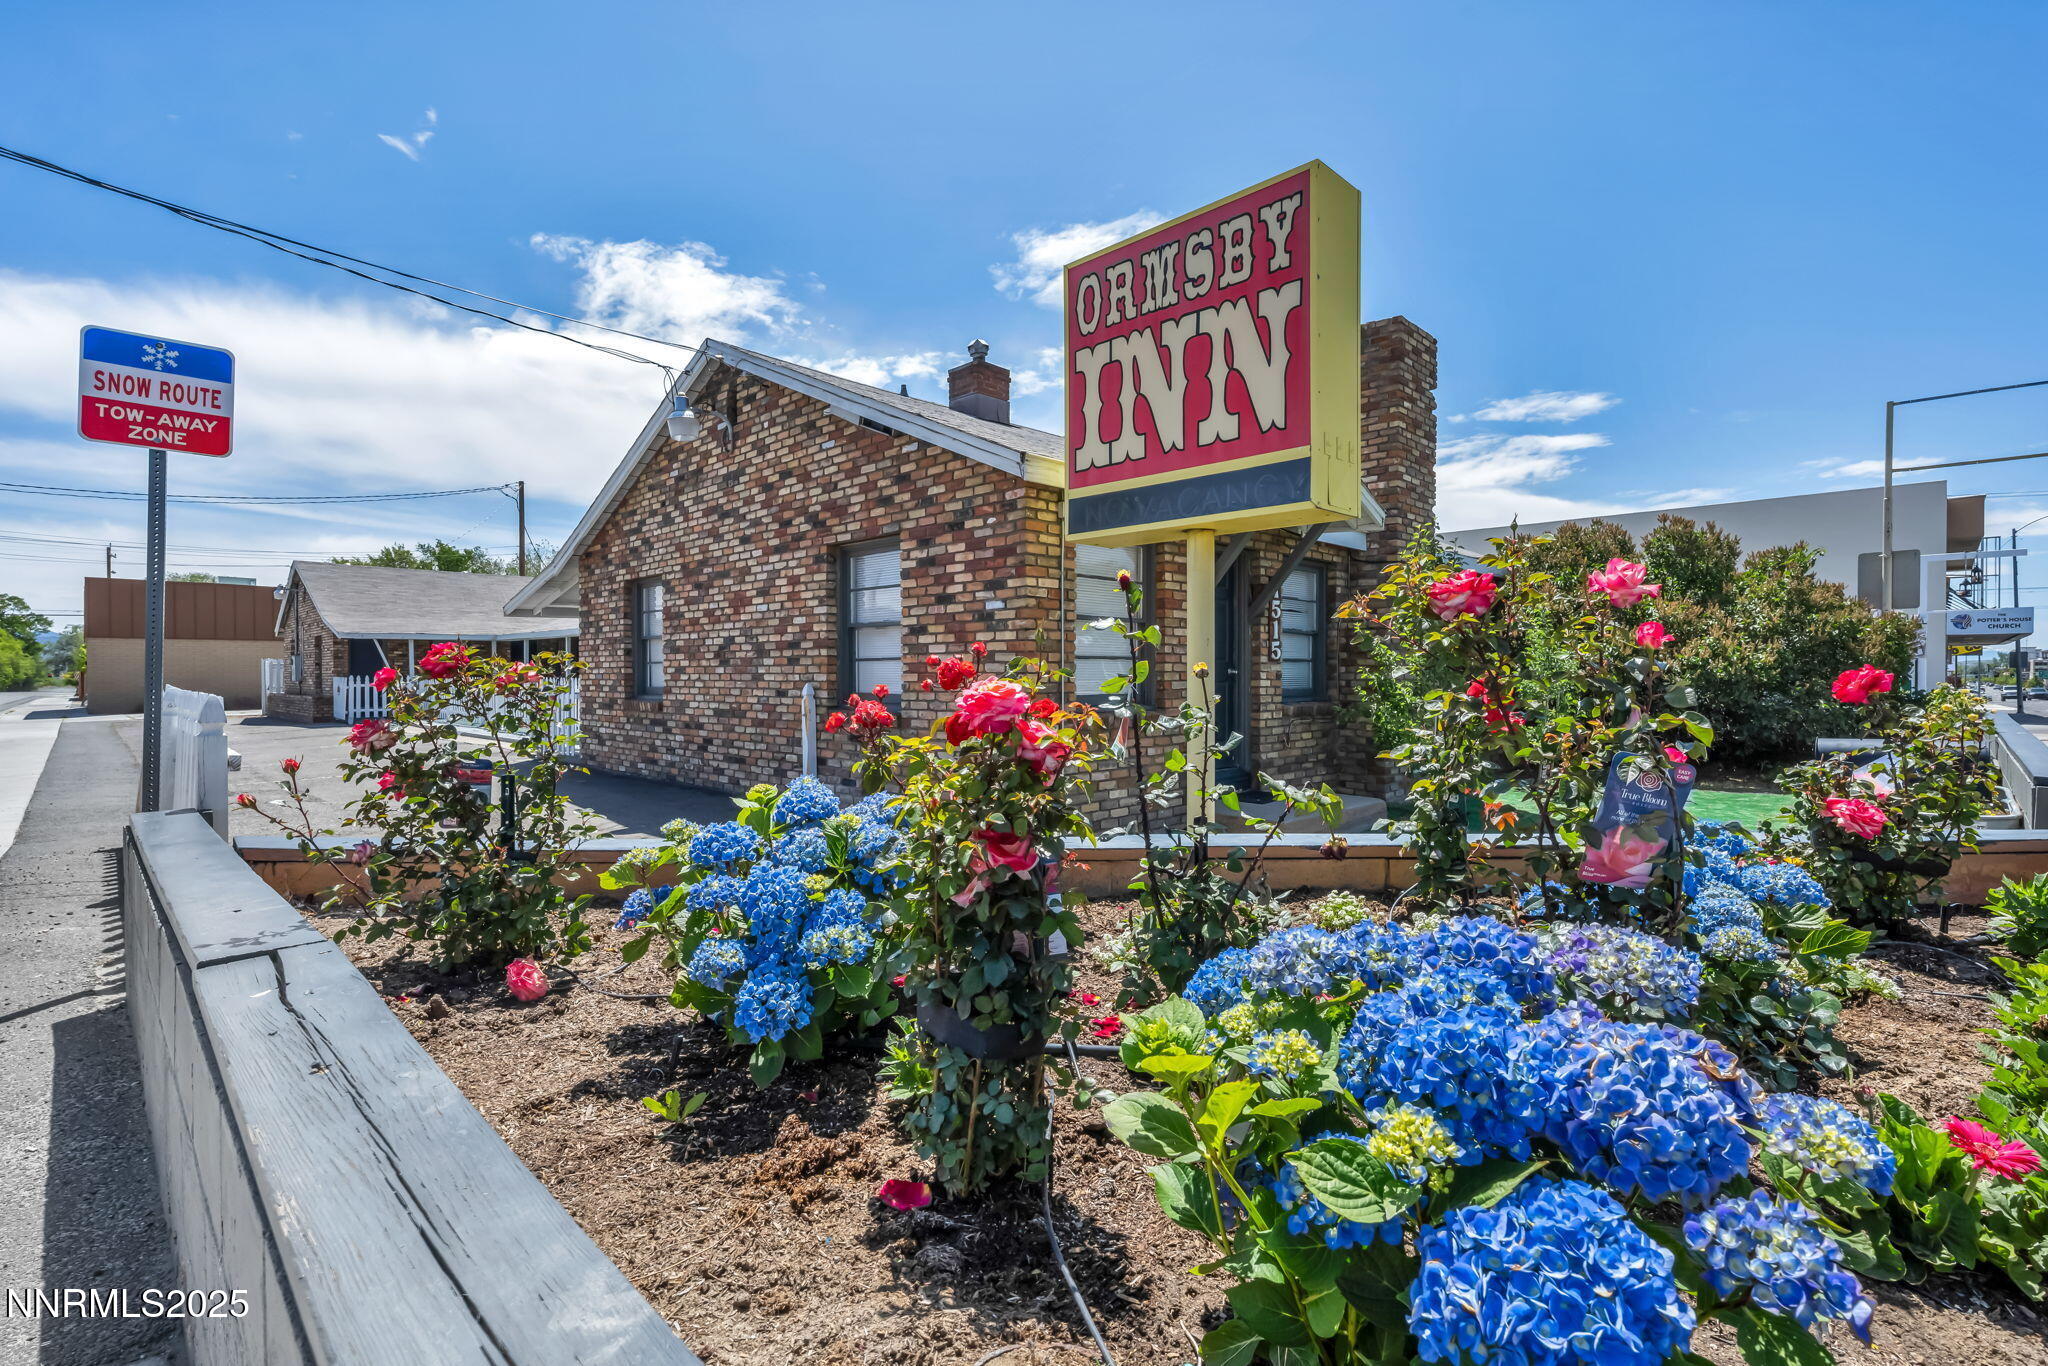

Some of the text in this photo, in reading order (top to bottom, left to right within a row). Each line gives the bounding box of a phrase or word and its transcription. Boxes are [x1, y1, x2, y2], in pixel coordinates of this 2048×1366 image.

[1075, 190, 1303, 337] ORMSBY
[93, 369, 222, 410] SNOW ROUTE
[1074, 278, 1303, 473] INN
[95, 403, 218, 433] TOW-AWAY
[127, 424, 187, 446] ZONE
[1621, 788, 1641, 800] True
[1641, 792, 1668, 806] Bloom
